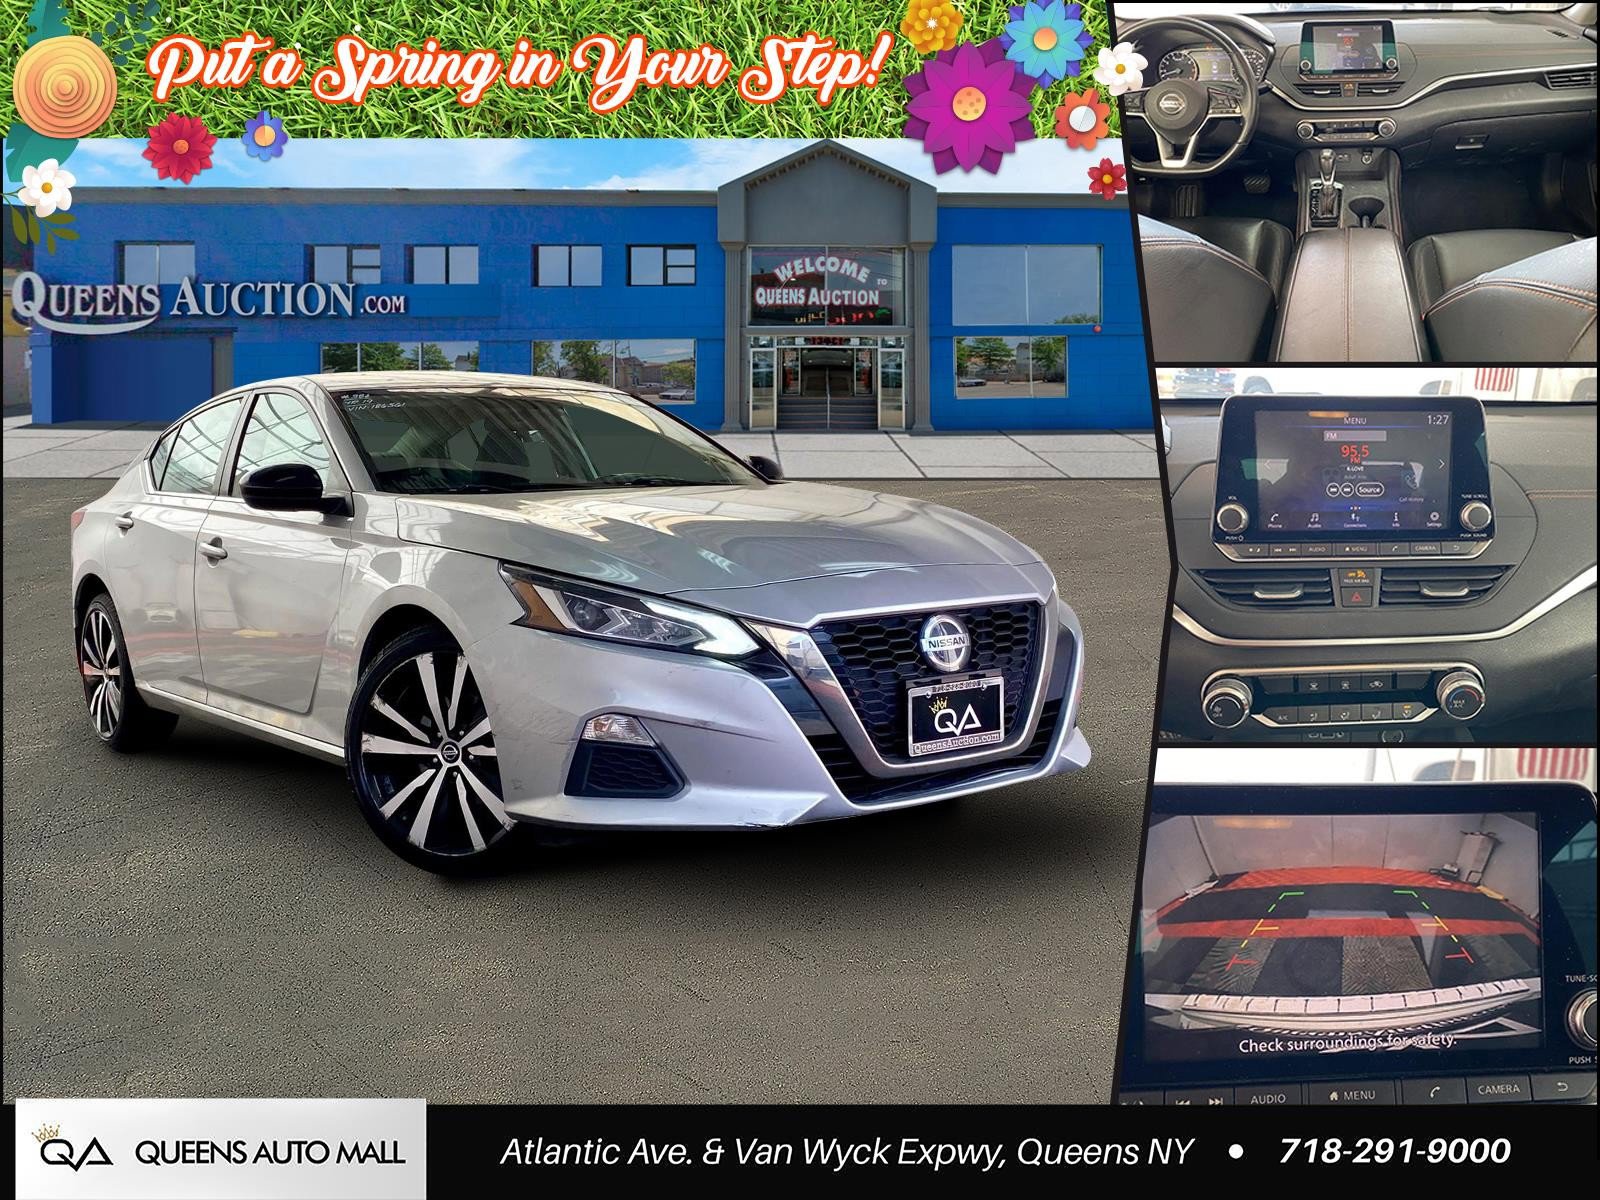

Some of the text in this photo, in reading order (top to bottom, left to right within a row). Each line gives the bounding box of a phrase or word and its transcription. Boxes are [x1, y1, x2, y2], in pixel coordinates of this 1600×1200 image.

[773, 256, 872, 283] WELCOME
[12, 271, 161, 334] QUEENS
[755, 287, 880, 306] QUEENS AUCTION
[1344, 415, 1449, 425] MENU 1:27
[1340, 445, 1370, 458] 95.5
[1358, 485, 1381, 494] Source
[928, 636, 966, 649] NISSAN
[935, 703, 982, 737] QA
[914, 733, 1000, 754] QueensAuction.com
[1239, 1032, 1458, 1053] Check surroundings for safety.
[1568, 1056, 1592, 1064] PUSH
[1343, 1090, 1376, 1101] MENU
[1478, 1083, 1521, 1095] CAMERA
[1250, 1093, 1287, 1105] AUDIO
